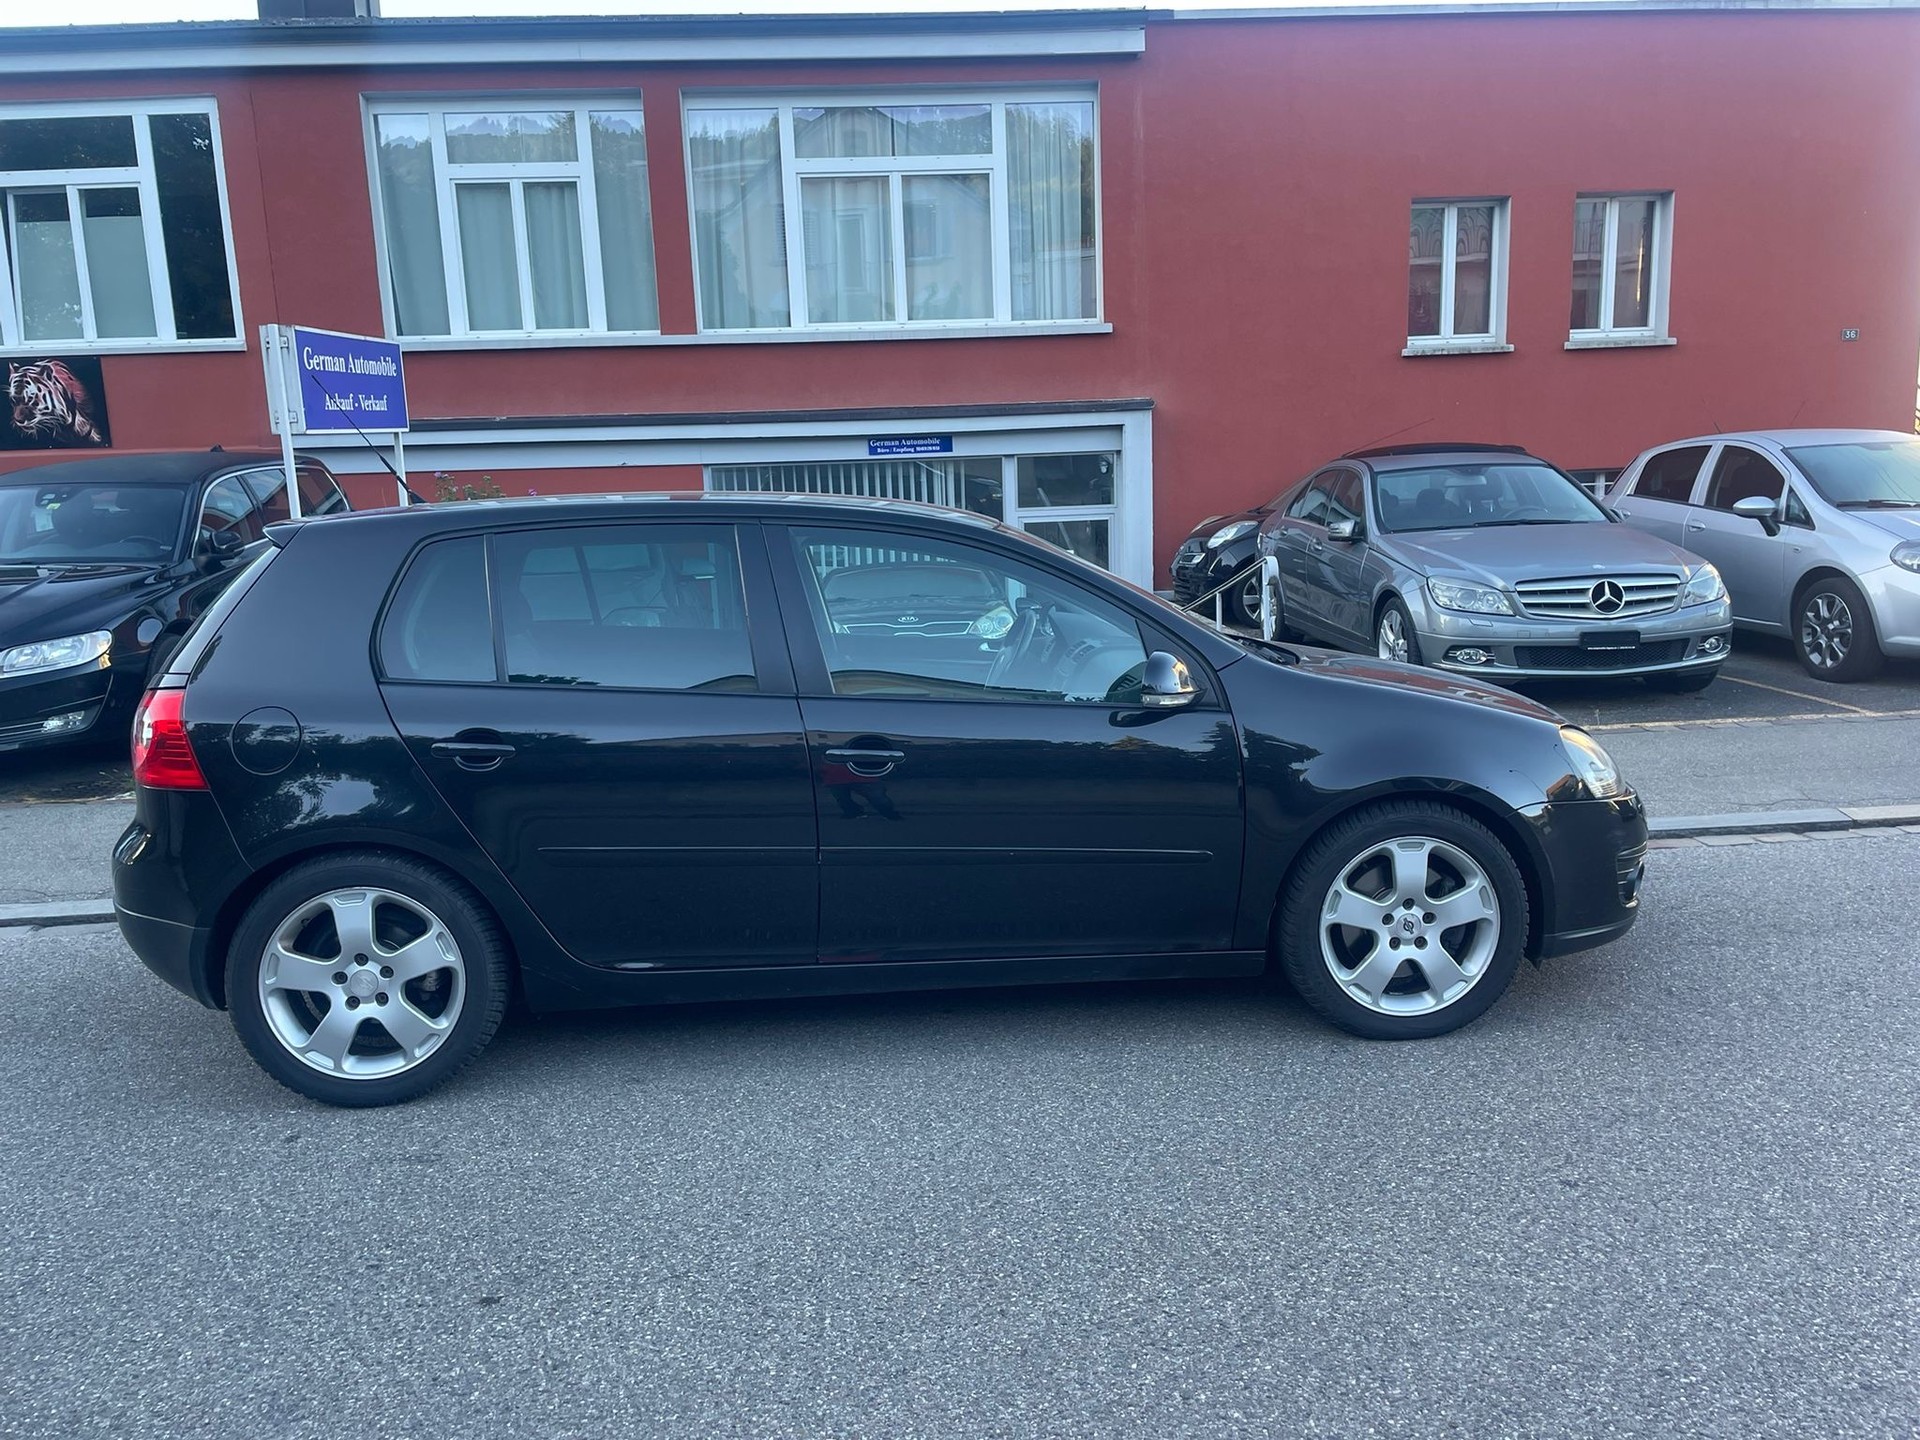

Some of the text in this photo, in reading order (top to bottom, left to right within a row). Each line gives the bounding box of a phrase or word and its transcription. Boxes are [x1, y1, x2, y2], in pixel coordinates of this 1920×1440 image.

[1845, 330, 1856, 339] 36
[303, 346, 397, 377] German Automobile
[325, 393, 354, 411] Ankauf
[358, 394, 388, 411] Verkauf
[870, 437, 941, 447] German Automobile
